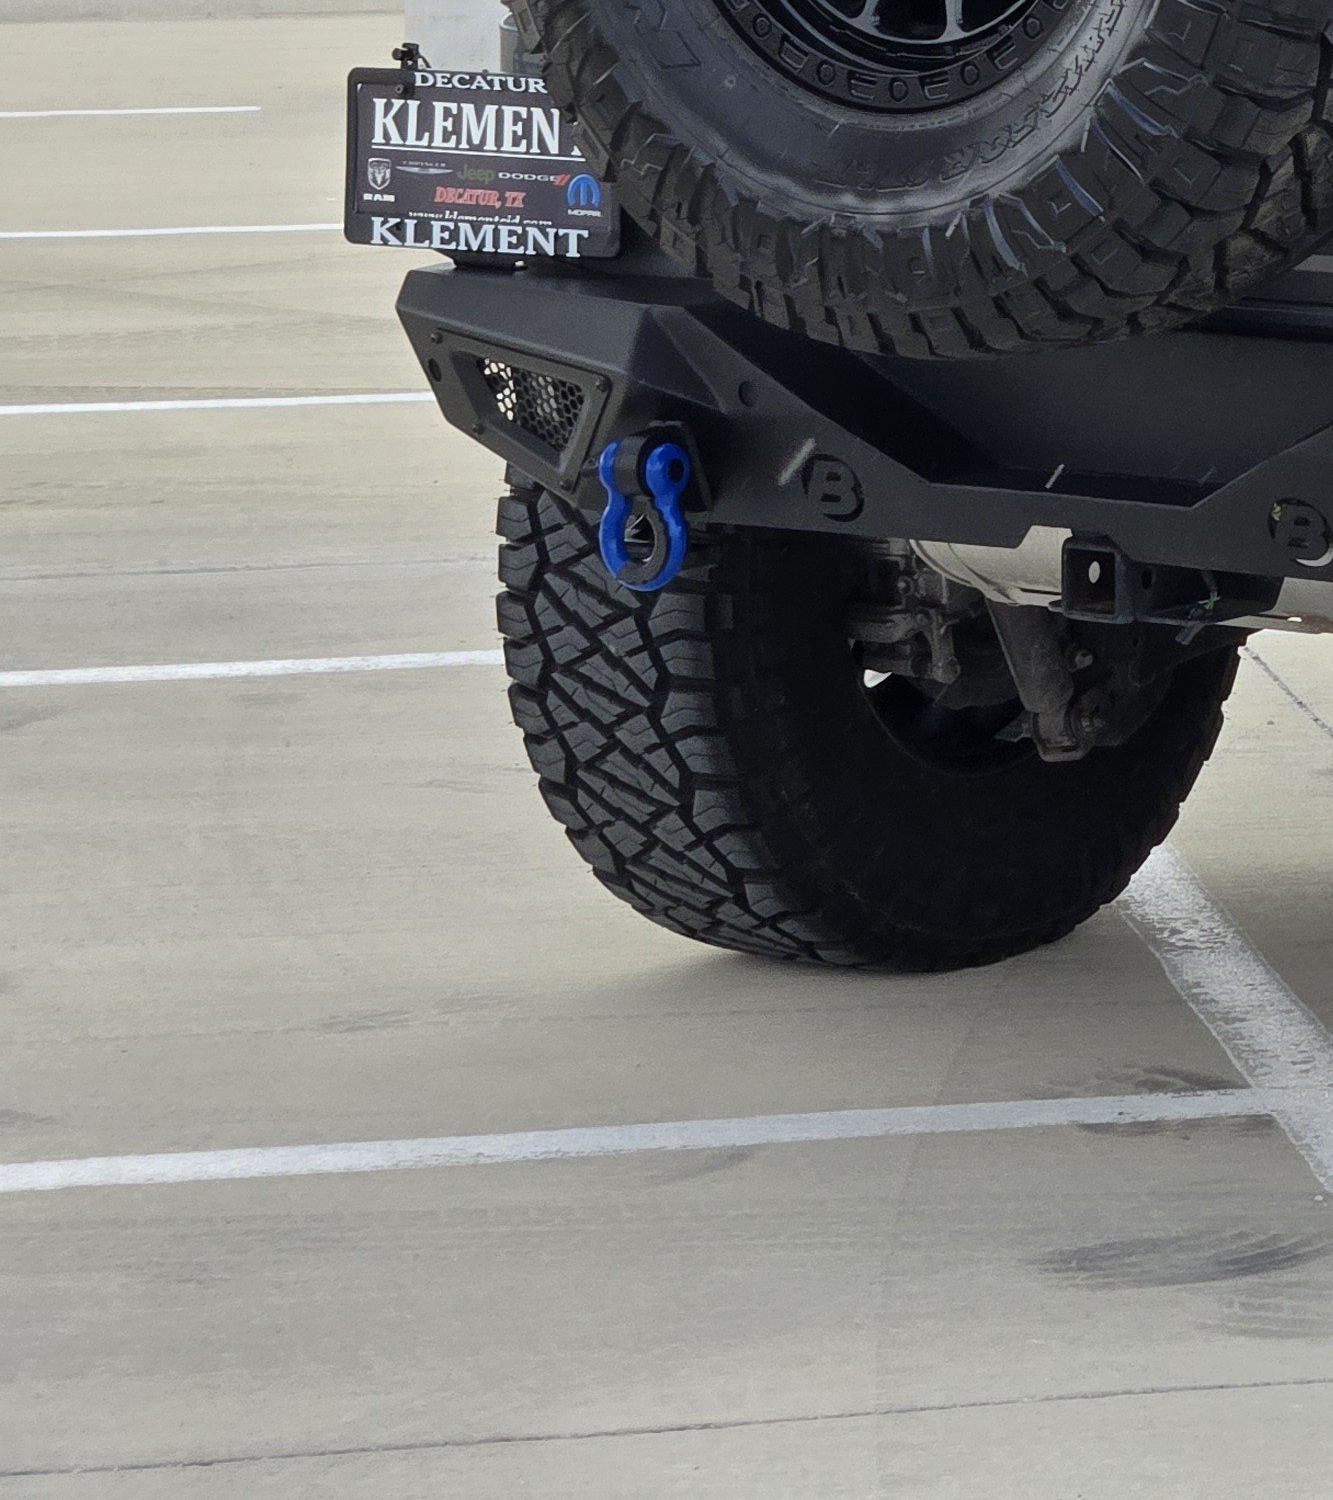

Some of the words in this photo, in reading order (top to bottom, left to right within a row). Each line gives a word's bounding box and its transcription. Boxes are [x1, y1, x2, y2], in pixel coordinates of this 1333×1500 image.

[414, 71, 548, 94] DECATUR
[371, 97, 583, 157] KLEMEN
[498, 171, 558, 182] DODGE
[433, 186, 501, 209] DECATUR,
[505, 191, 527, 209] TX
[370, 216, 589, 258] KLEMENT
